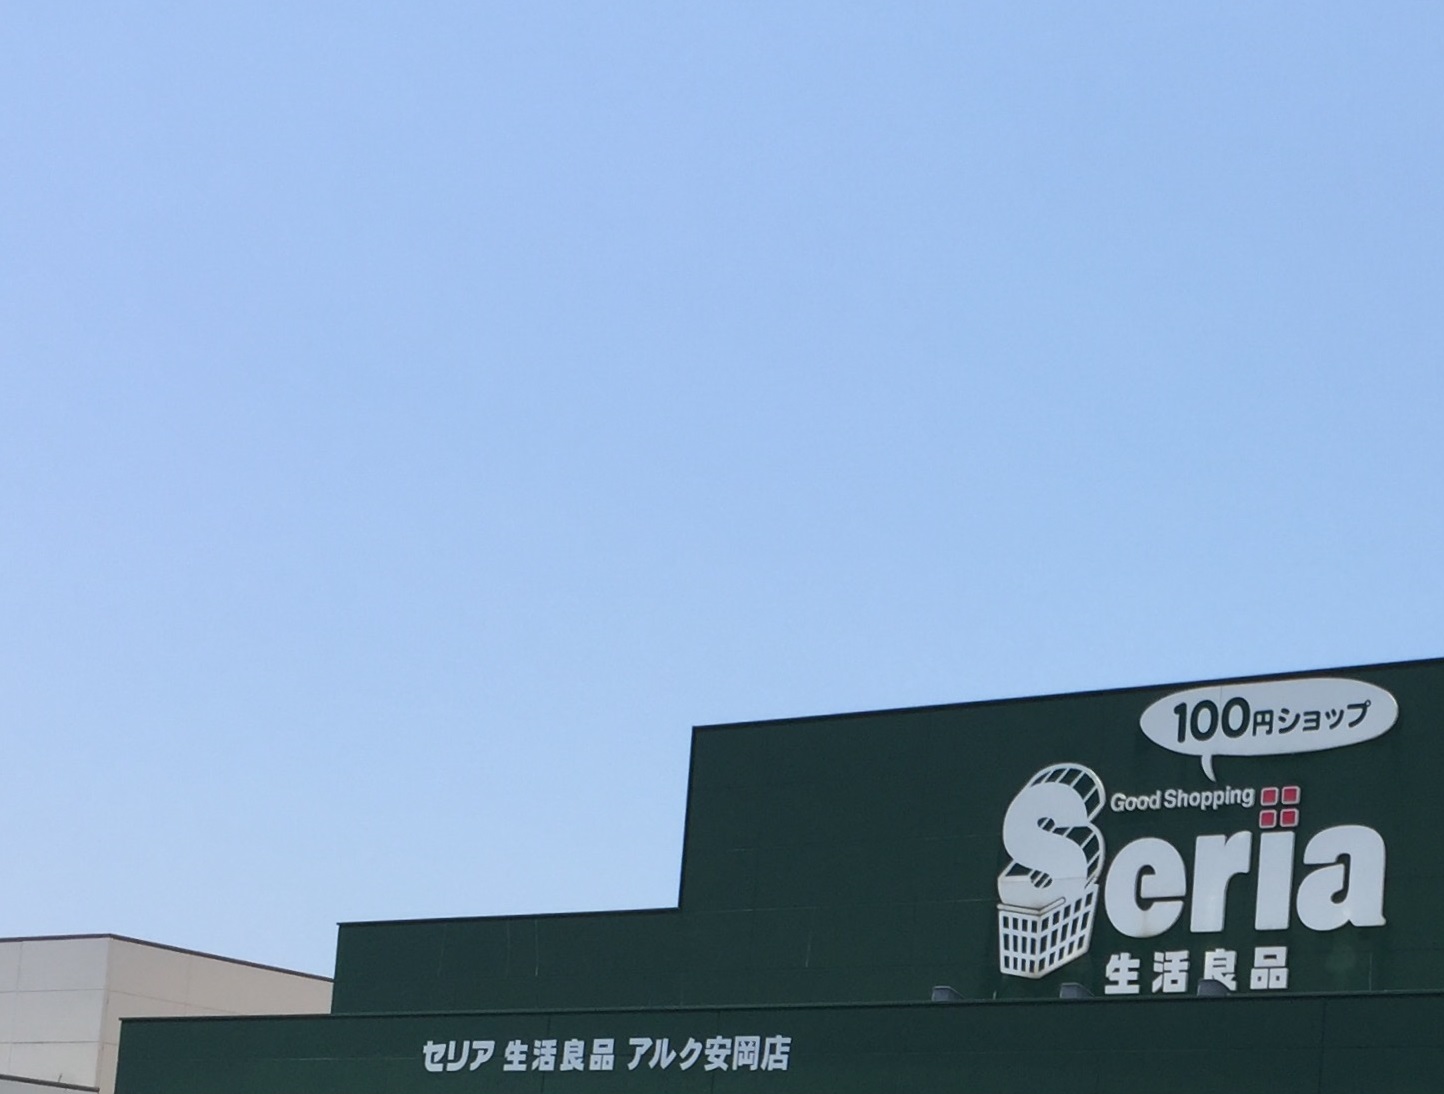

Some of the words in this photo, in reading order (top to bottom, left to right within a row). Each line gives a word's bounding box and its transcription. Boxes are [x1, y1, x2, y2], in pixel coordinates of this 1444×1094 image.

[1174, 697, 1372, 743] 100円ショップ
[1110, 789, 1161, 812] Good
[1163, 785, 1256, 811] Shopping
[998, 763, 1387, 978] Seria
[1104, 946, 1288, 995] 生活良品
[423, 1040, 495, 1072] セリア
[503, 1038, 615, 1072] 生活良品
[627, 1034, 792, 1072] アルク安岡店
